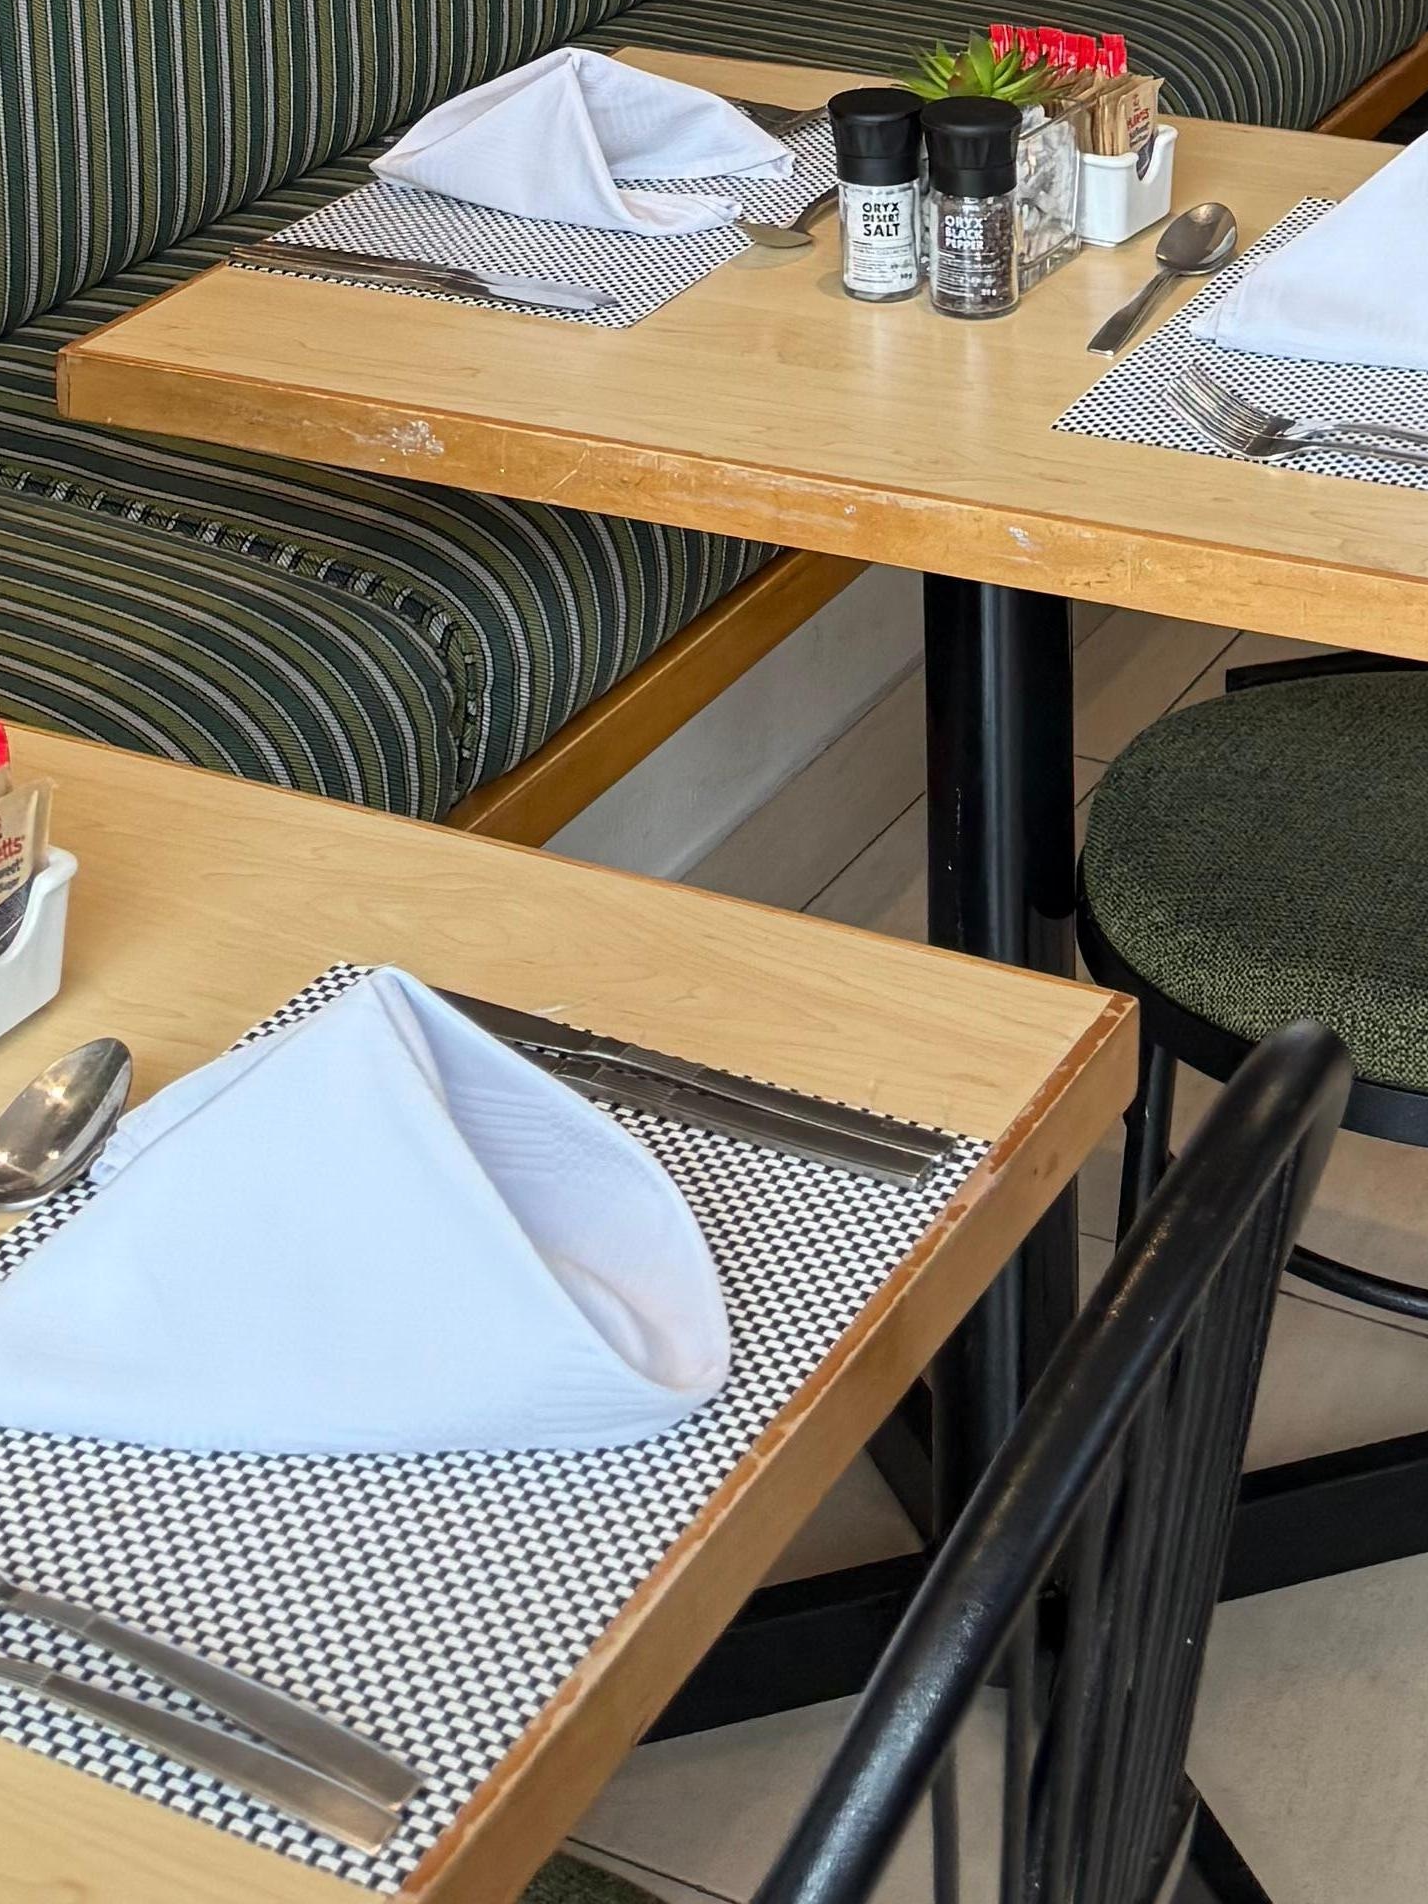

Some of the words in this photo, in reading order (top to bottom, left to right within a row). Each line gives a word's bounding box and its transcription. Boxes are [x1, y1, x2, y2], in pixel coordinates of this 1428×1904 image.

[862, 202, 899, 213] ORYX
[862, 213, 900, 223] DESERT
[944, 215, 983, 229] ORYX
[863, 223, 901, 237] SALT
[945, 227, 984, 240] BLACK
[945, 239, 984, 251] PEPPER
